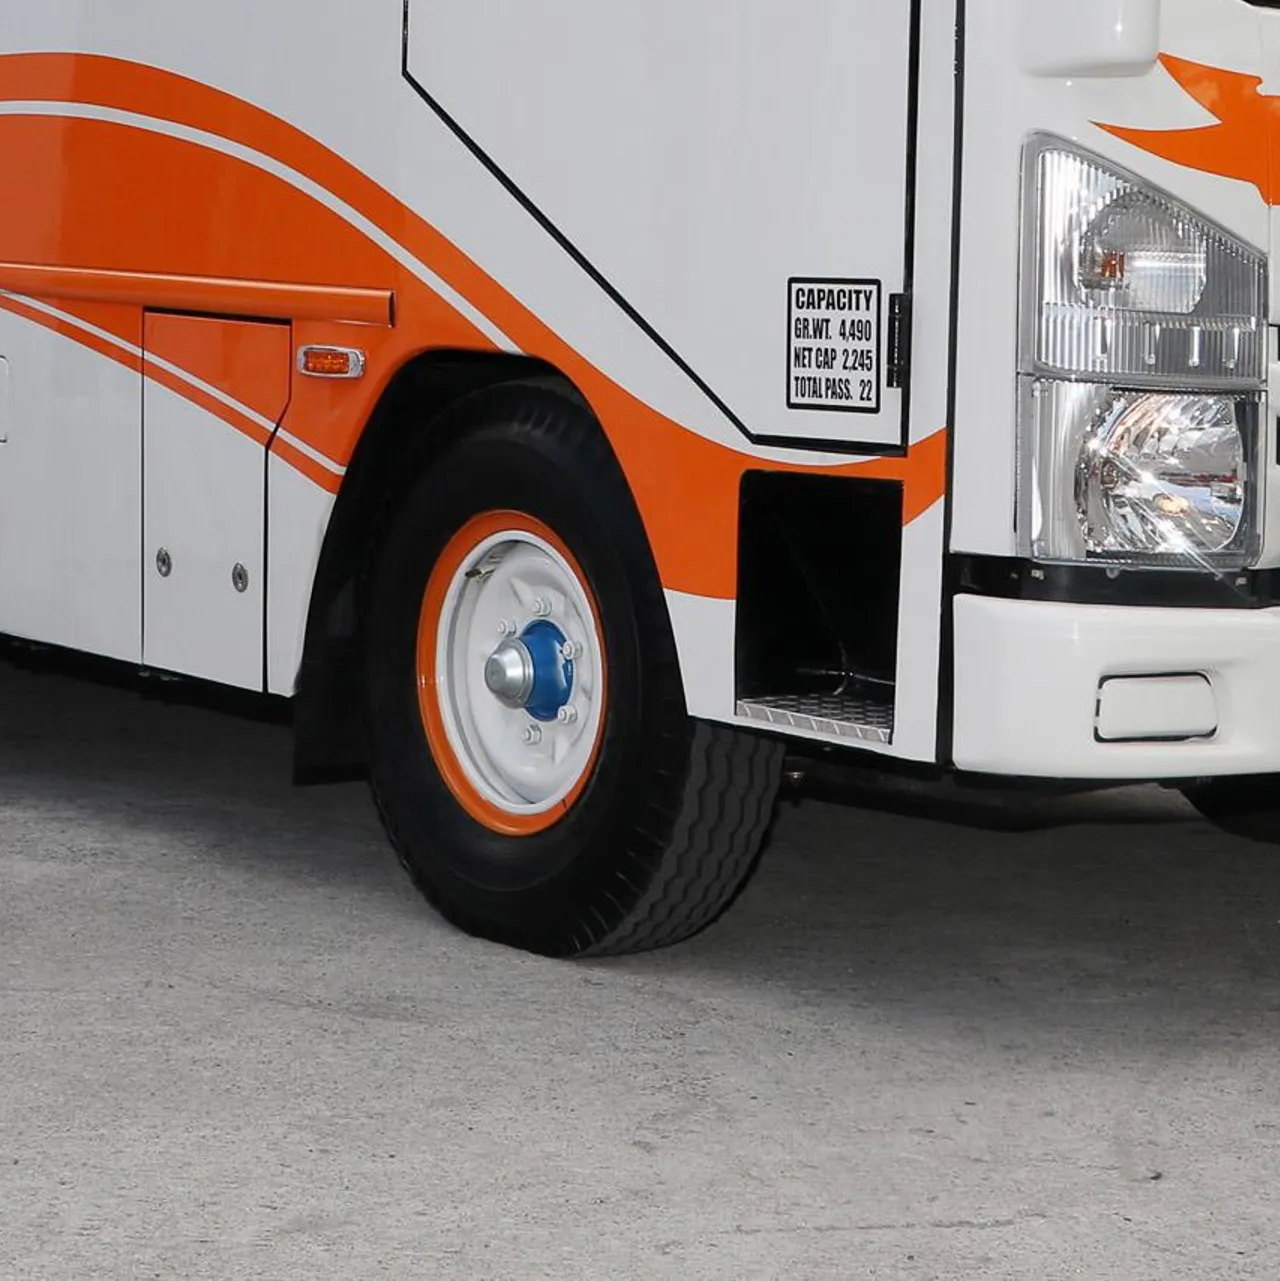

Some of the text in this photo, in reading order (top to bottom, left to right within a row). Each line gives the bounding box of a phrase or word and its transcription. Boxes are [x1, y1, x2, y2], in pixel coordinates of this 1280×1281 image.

[795, 287, 873, 312] CAPACITY
[839, 318, 872, 342] 4,490
[794, 346, 873, 373] NET CAP 2,245
[794, 375, 872, 402] TOTAL PASS. 22
